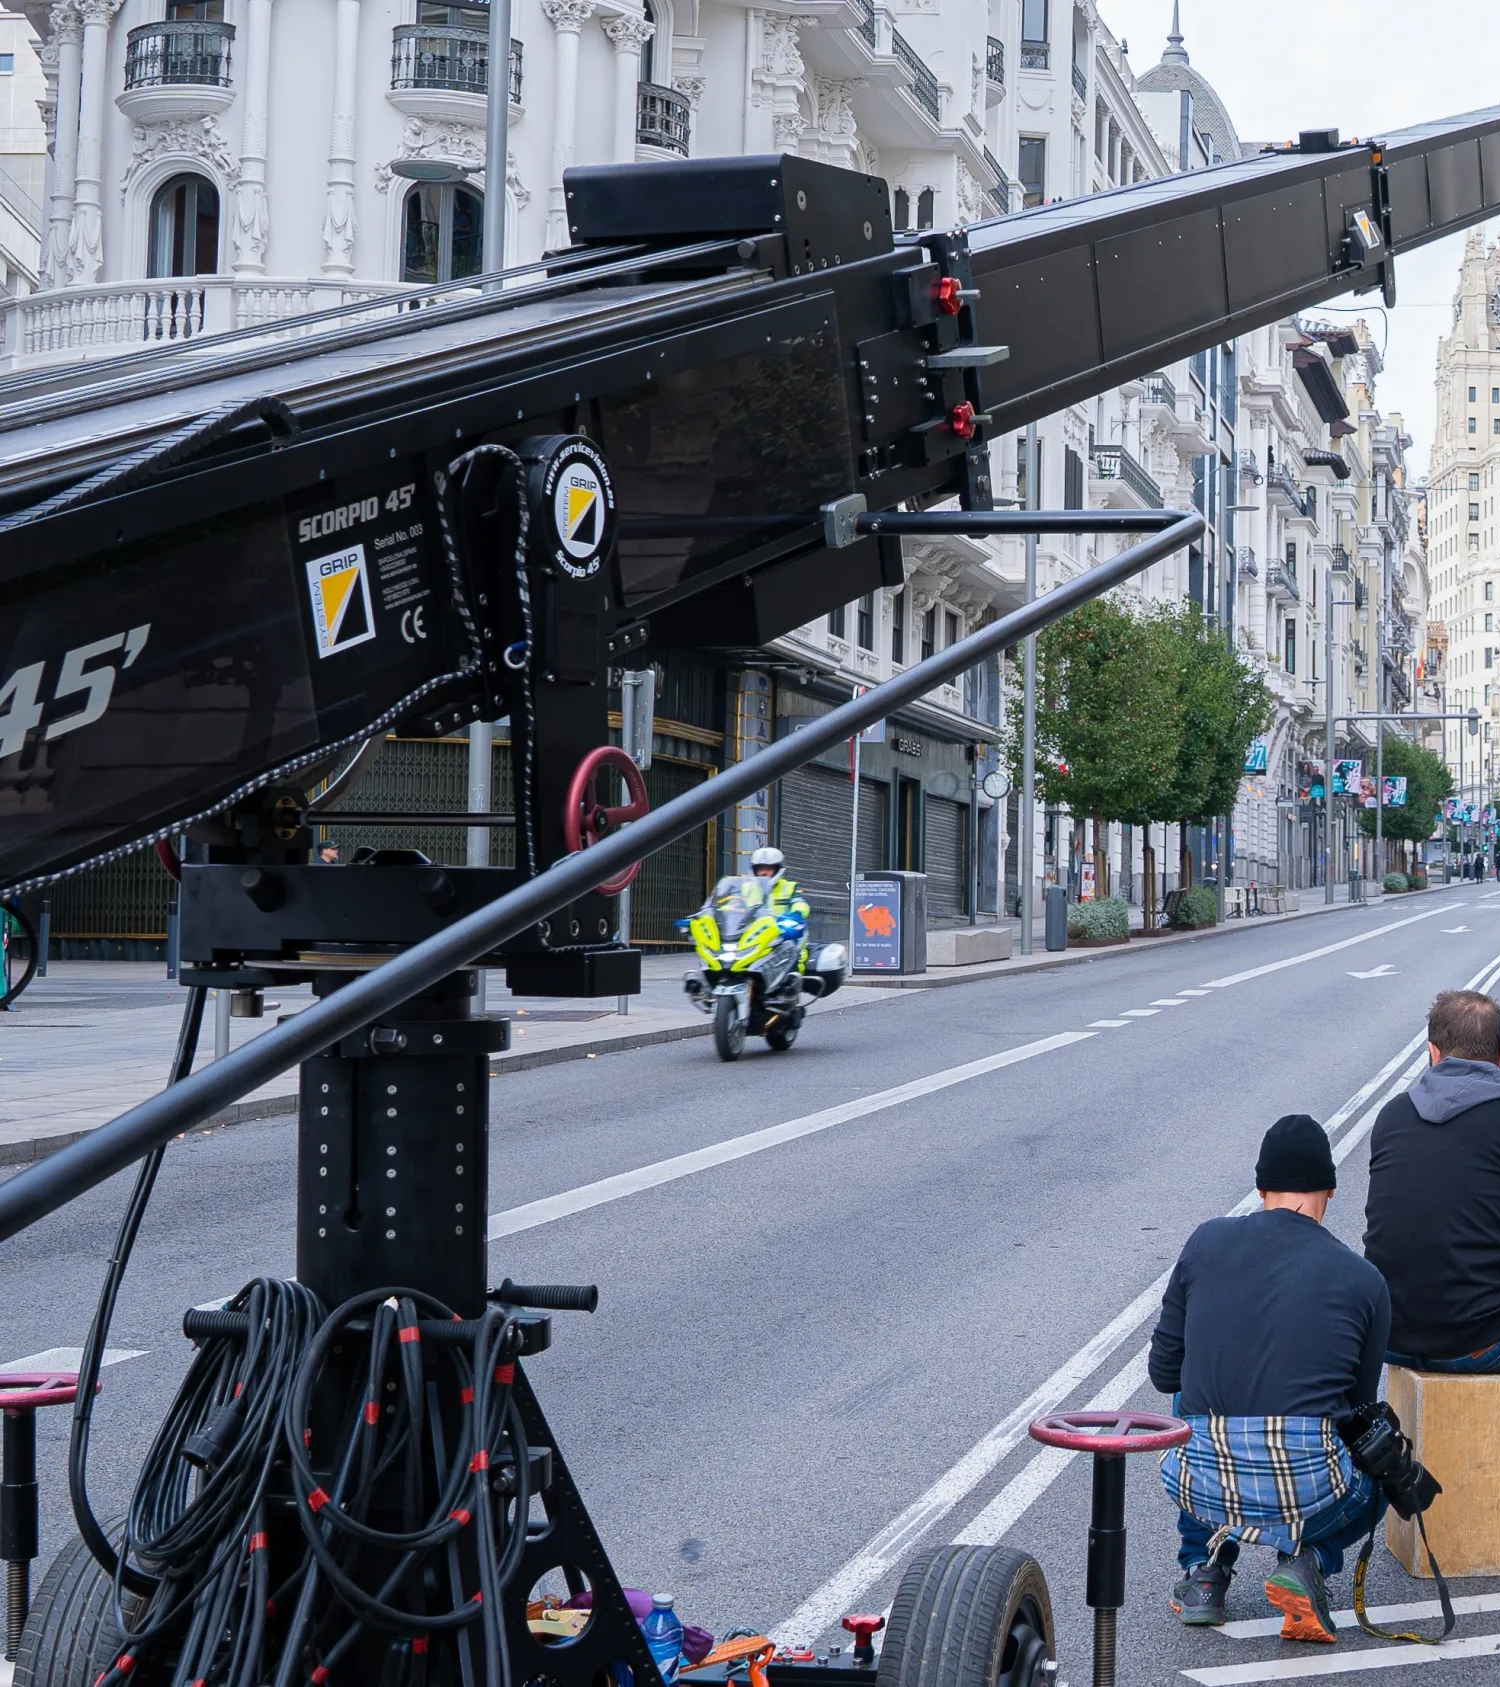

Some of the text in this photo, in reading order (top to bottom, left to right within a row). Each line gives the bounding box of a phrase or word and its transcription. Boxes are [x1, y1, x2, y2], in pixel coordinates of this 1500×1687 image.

[570, 476, 597, 491] GRIP
[299, 483, 415, 543] SCORPIO 45'
[374, 523, 424, 550] Serial No. 003
[319, 553, 358, 577] GRIP
[555, 549, 586, 578] Scorpio
[312, 580, 330, 649] SYSTEM
[0, 623, 151, 759] 45'
